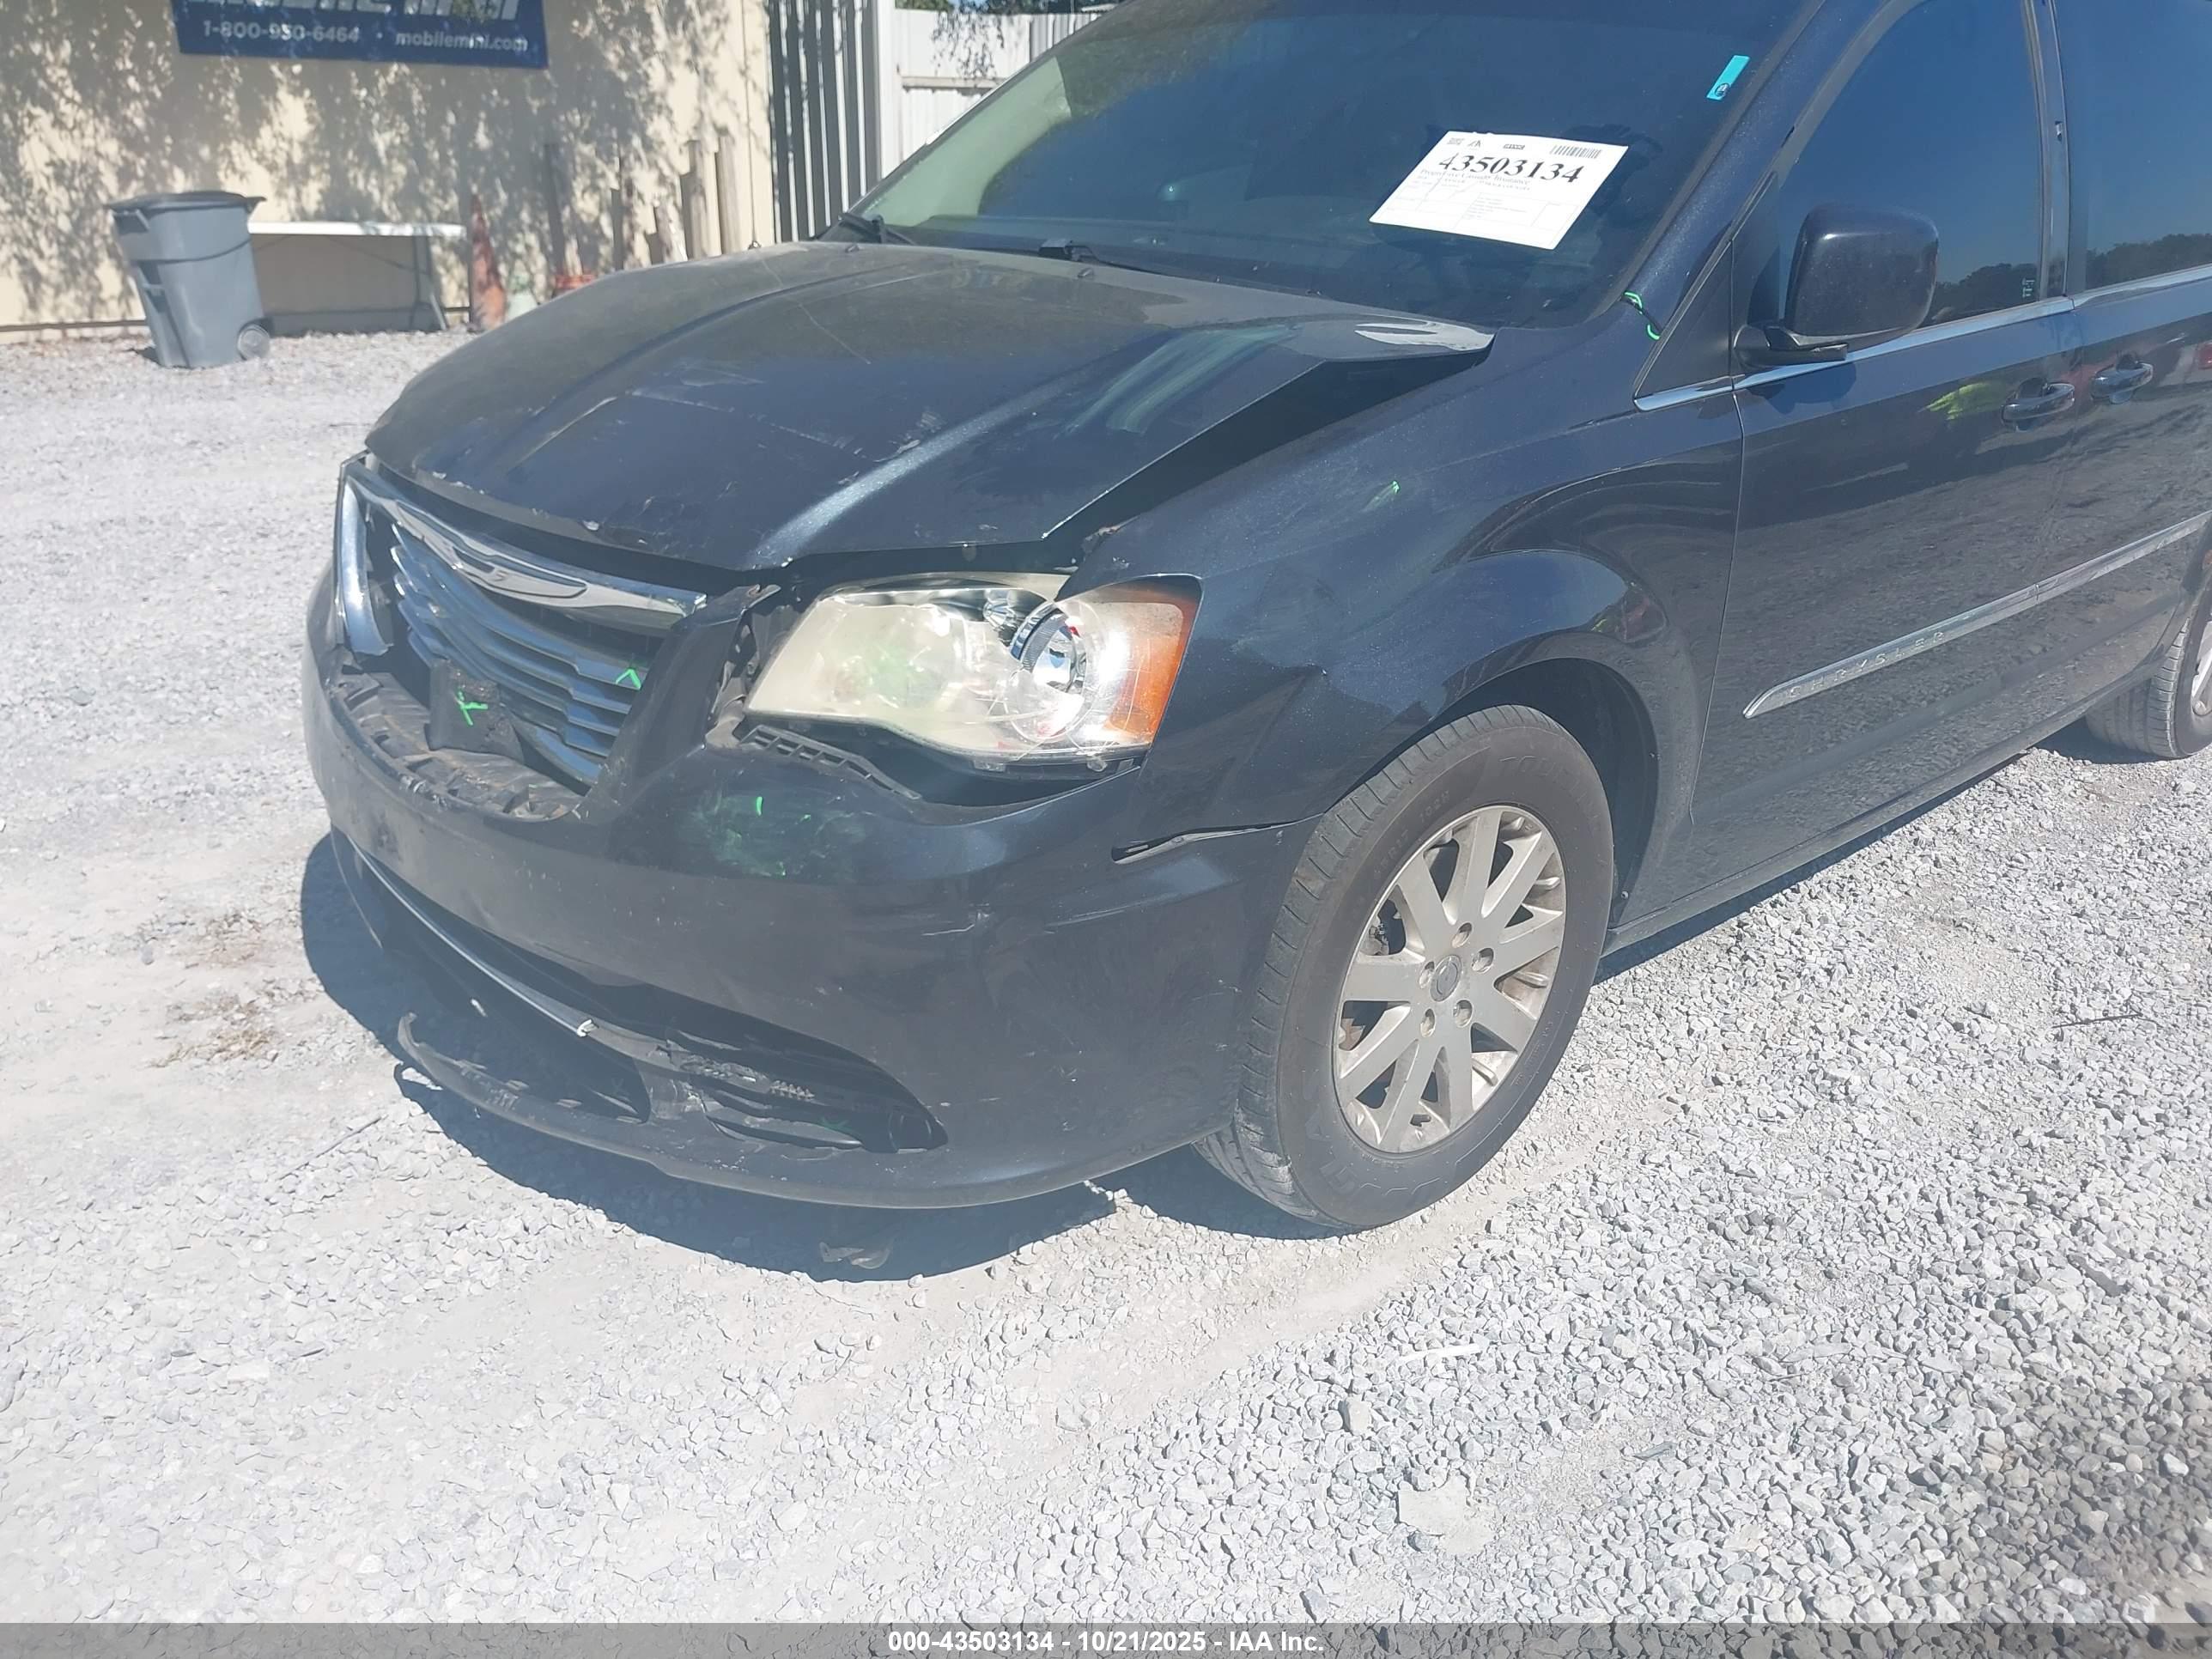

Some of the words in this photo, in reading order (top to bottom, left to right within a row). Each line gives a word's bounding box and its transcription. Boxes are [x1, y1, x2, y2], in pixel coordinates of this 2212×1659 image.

[203, 20, 360, 43] 1-800-950-6464
[395, 31, 529, 52] mobilemini.com
[1438, 151, 1585, 184] 43503134
